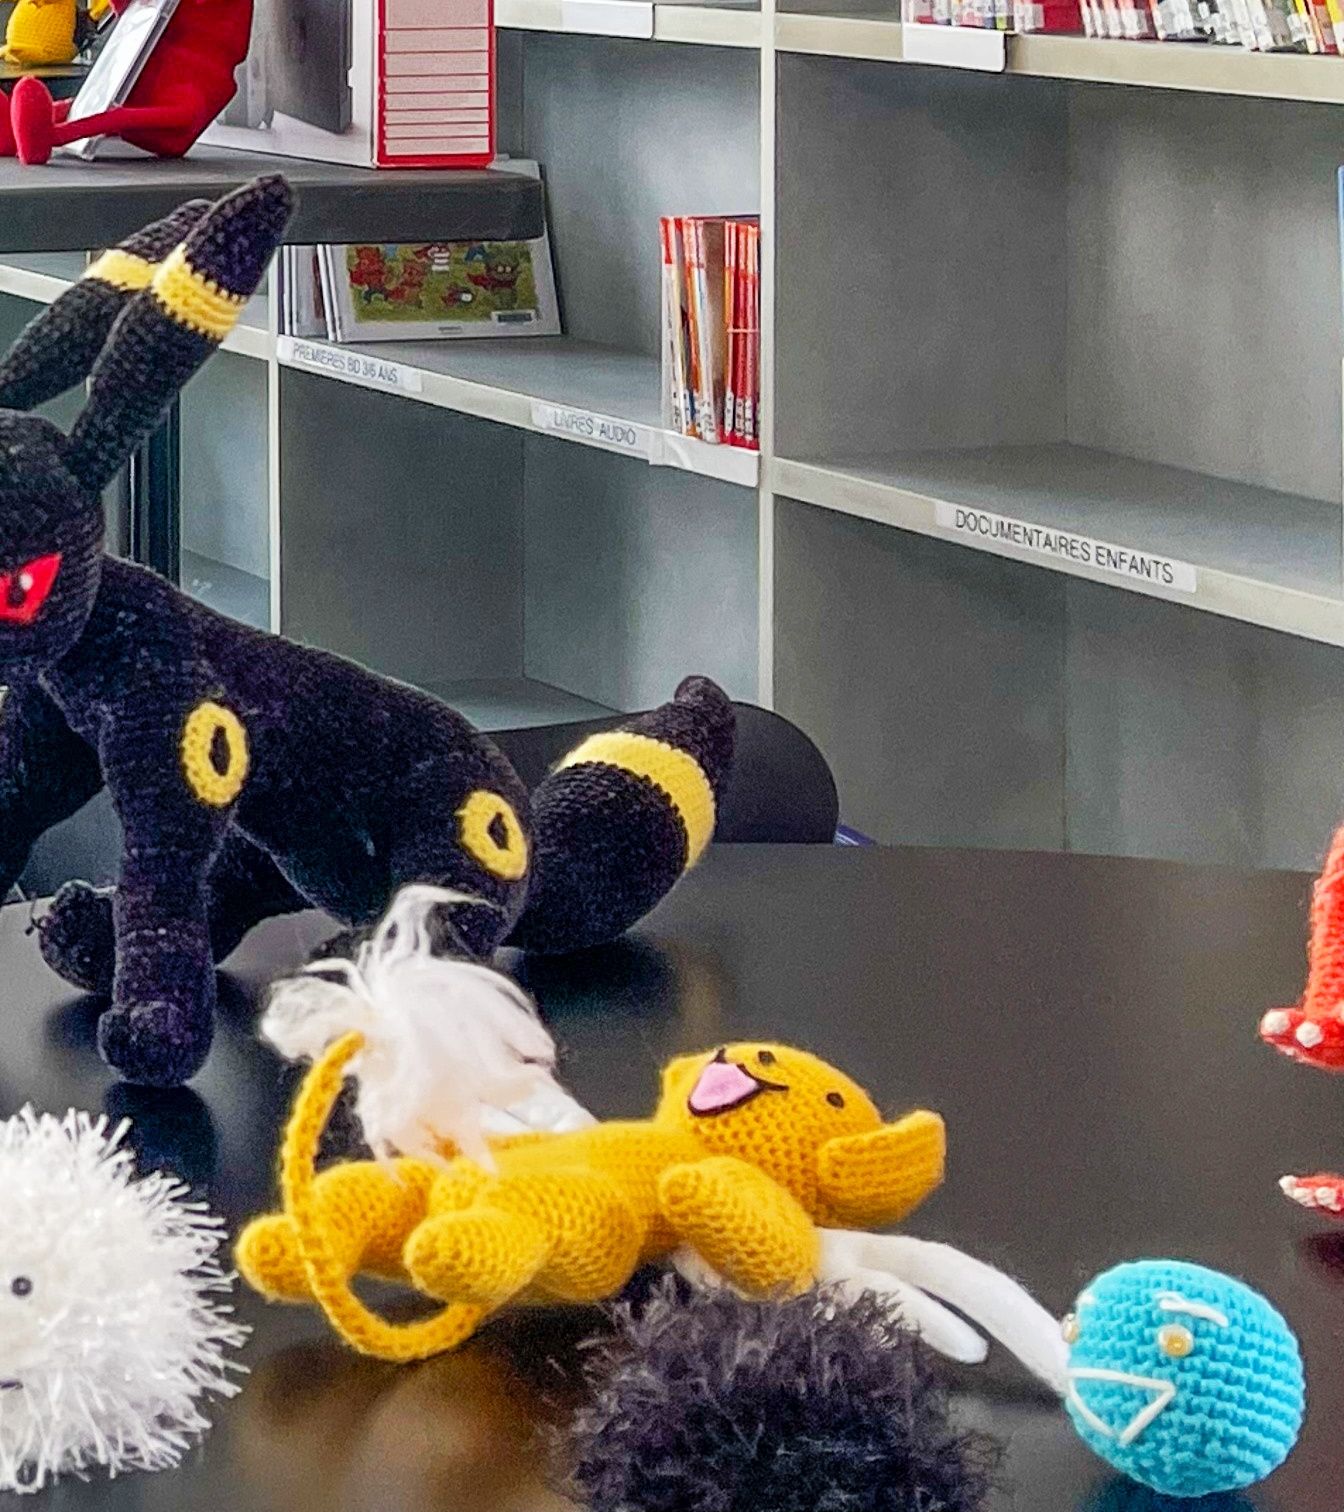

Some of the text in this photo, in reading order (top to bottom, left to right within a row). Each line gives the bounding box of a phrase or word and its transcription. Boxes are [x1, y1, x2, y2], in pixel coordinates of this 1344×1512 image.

[378, 365, 399, 384] ANS
[553, 409, 637, 446] LIVRES AUDIO
[955, 508, 1175, 585] DOCUMENTAIRES ENFANTS
